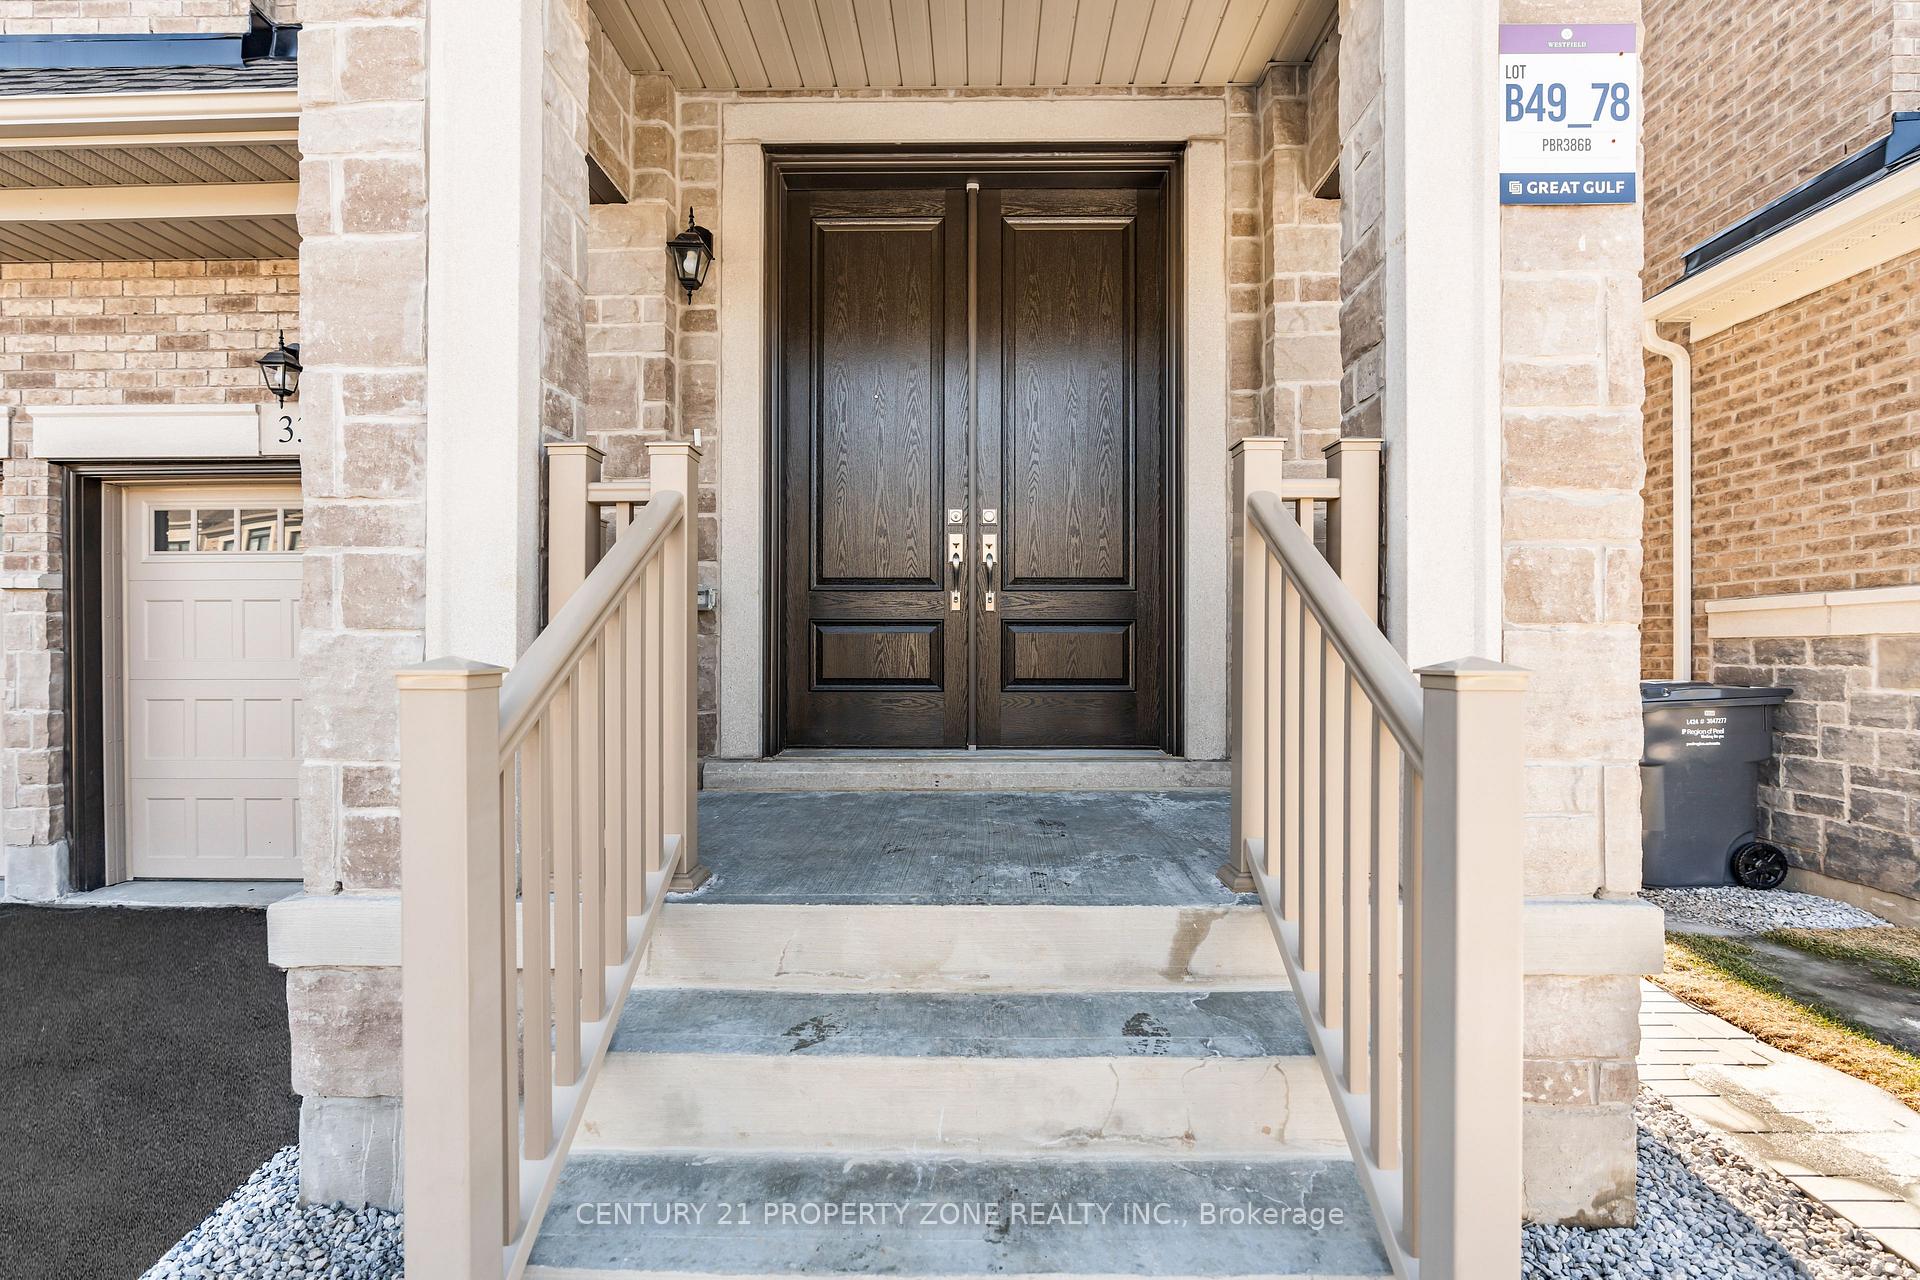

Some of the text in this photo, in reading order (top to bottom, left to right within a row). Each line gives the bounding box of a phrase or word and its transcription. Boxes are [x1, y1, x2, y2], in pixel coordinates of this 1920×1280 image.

[1505, 65, 1527, 79] LOT
[1505, 83, 1630, 128] B49_78
[1542, 138, 1592, 151] PBR386B
[1526, 181, 1625, 194] GREAT GULF
[278, 415, 302, 443] 3
